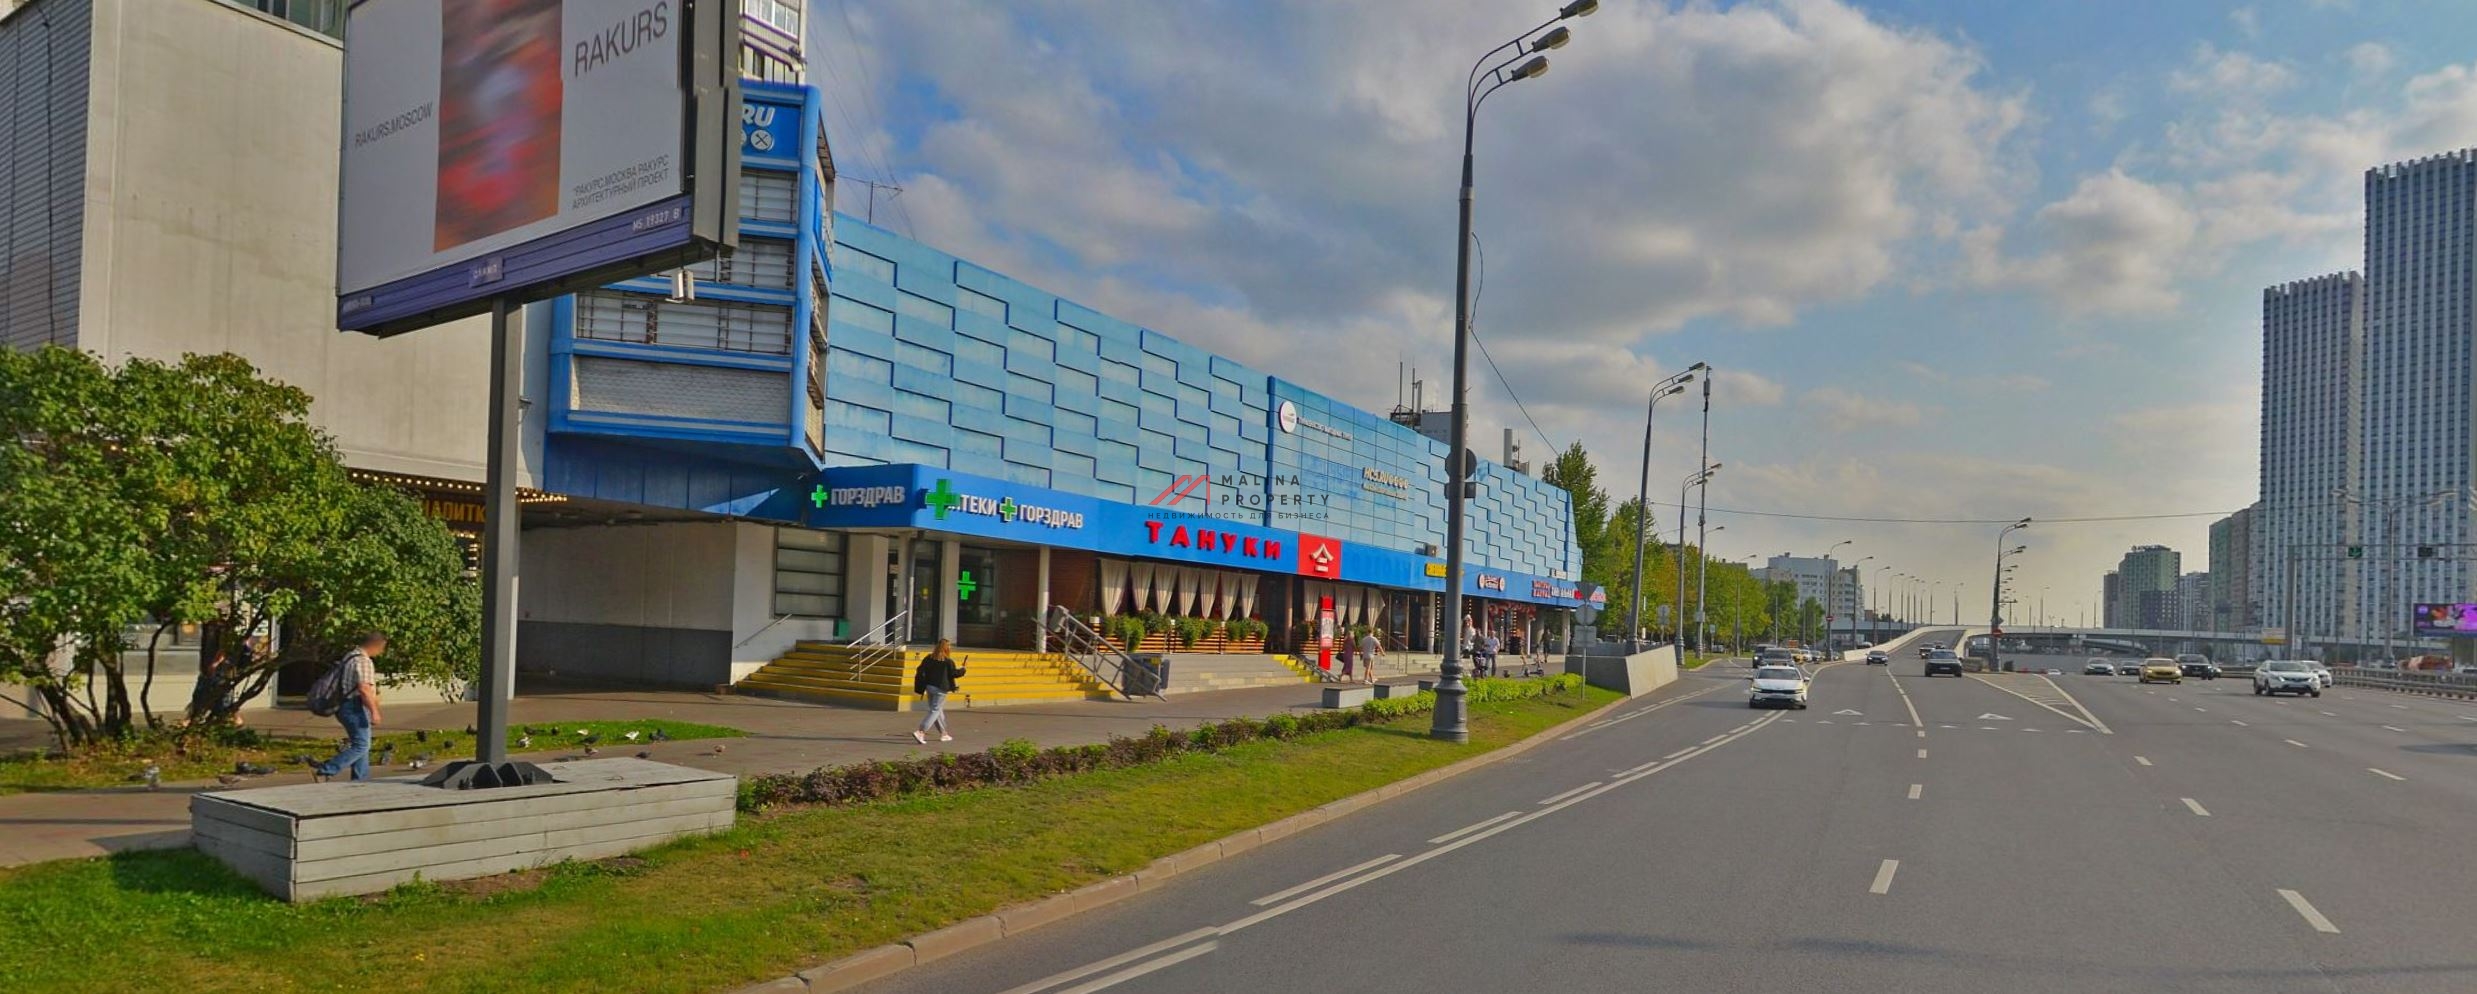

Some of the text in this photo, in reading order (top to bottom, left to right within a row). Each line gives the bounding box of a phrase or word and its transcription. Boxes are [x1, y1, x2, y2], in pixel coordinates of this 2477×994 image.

[574, 2, 668, 77] RAKURS
[355, 101, 432, 150] RAKURS.MOSCOW
[831, 485, 905, 508] ГОРЗДРАВ
[947, 494, 1084, 529] ТЕКИ ГОРЗДРАВ
[1144, 520, 1281, 560] ТАНУКИ
